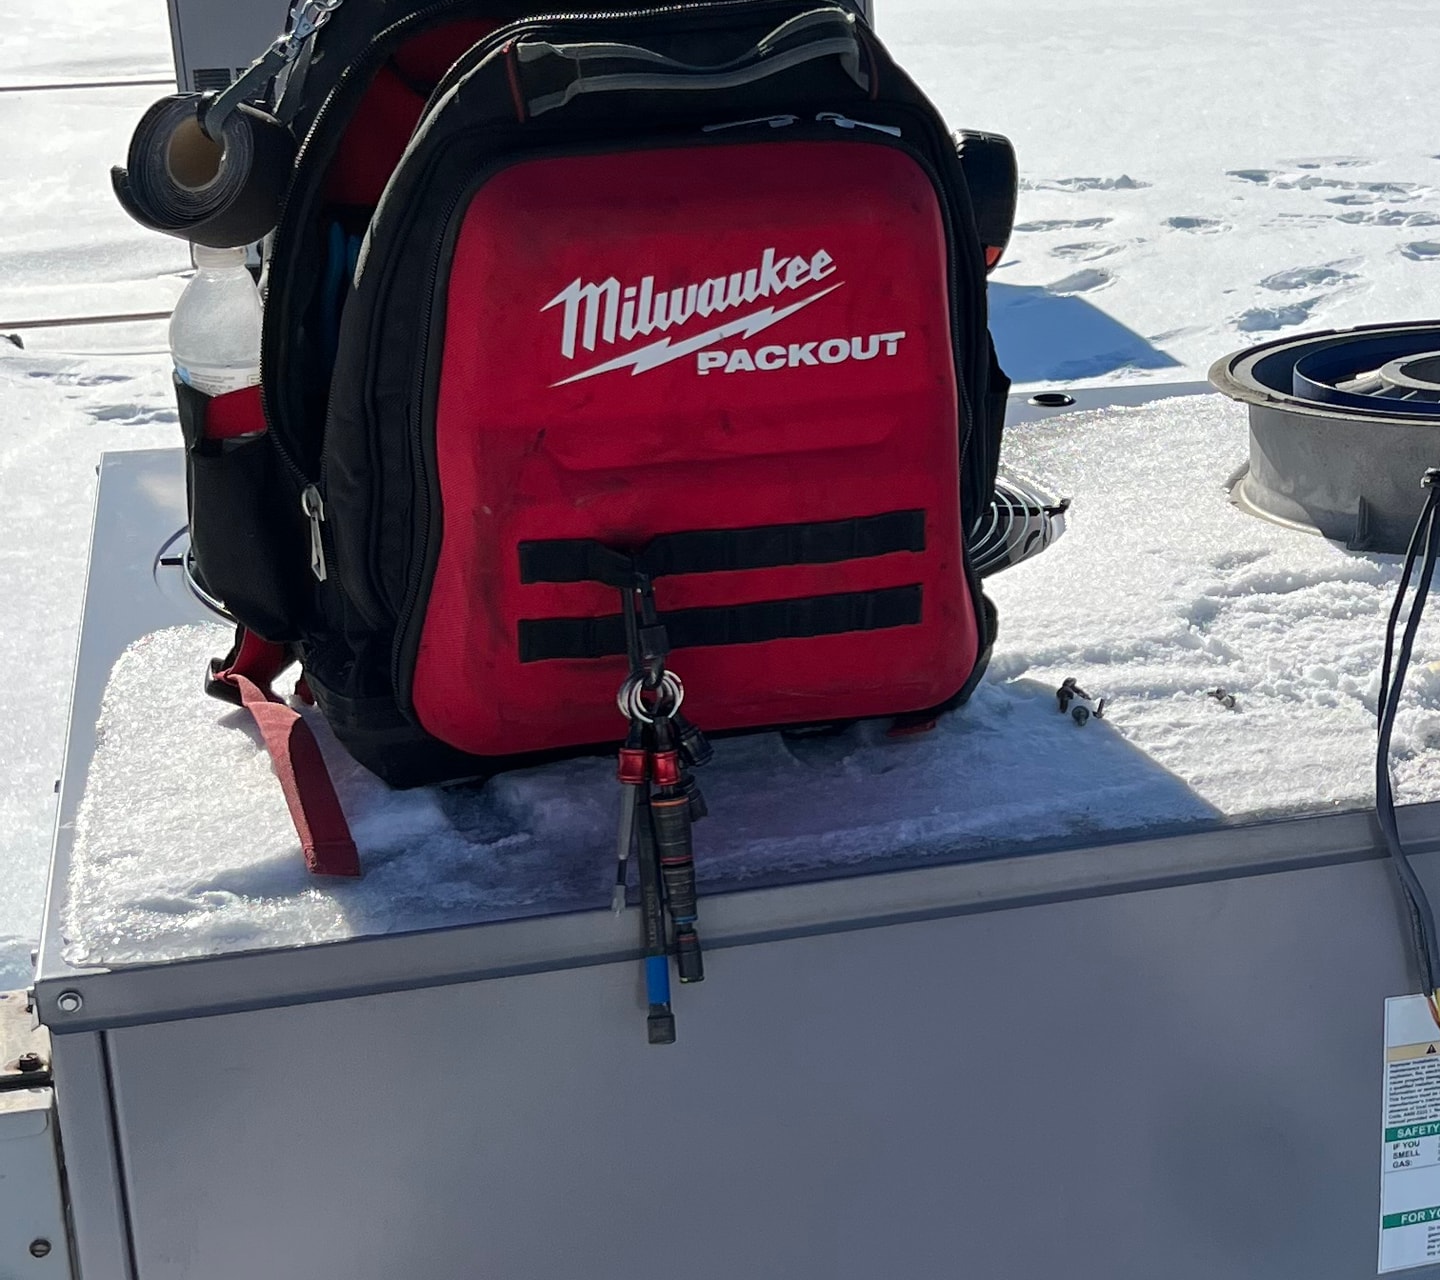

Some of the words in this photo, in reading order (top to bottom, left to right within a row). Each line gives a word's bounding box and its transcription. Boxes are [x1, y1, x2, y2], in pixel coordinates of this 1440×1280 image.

[540, 247, 837, 359] Milwaukee
[697, 332, 905, 375] PACKOUT
[1397, 1122, 1440, 1138] SAFETY
[1393, 1141, 1400, 1150] IF
[1402, 1140, 1420, 1149] YOU
[1393, 1149, 1420, 1159] SMELL
[1393, 1160, 1413, 1169] GAS:
[1401, 1211, 1427, 1224] FOR
